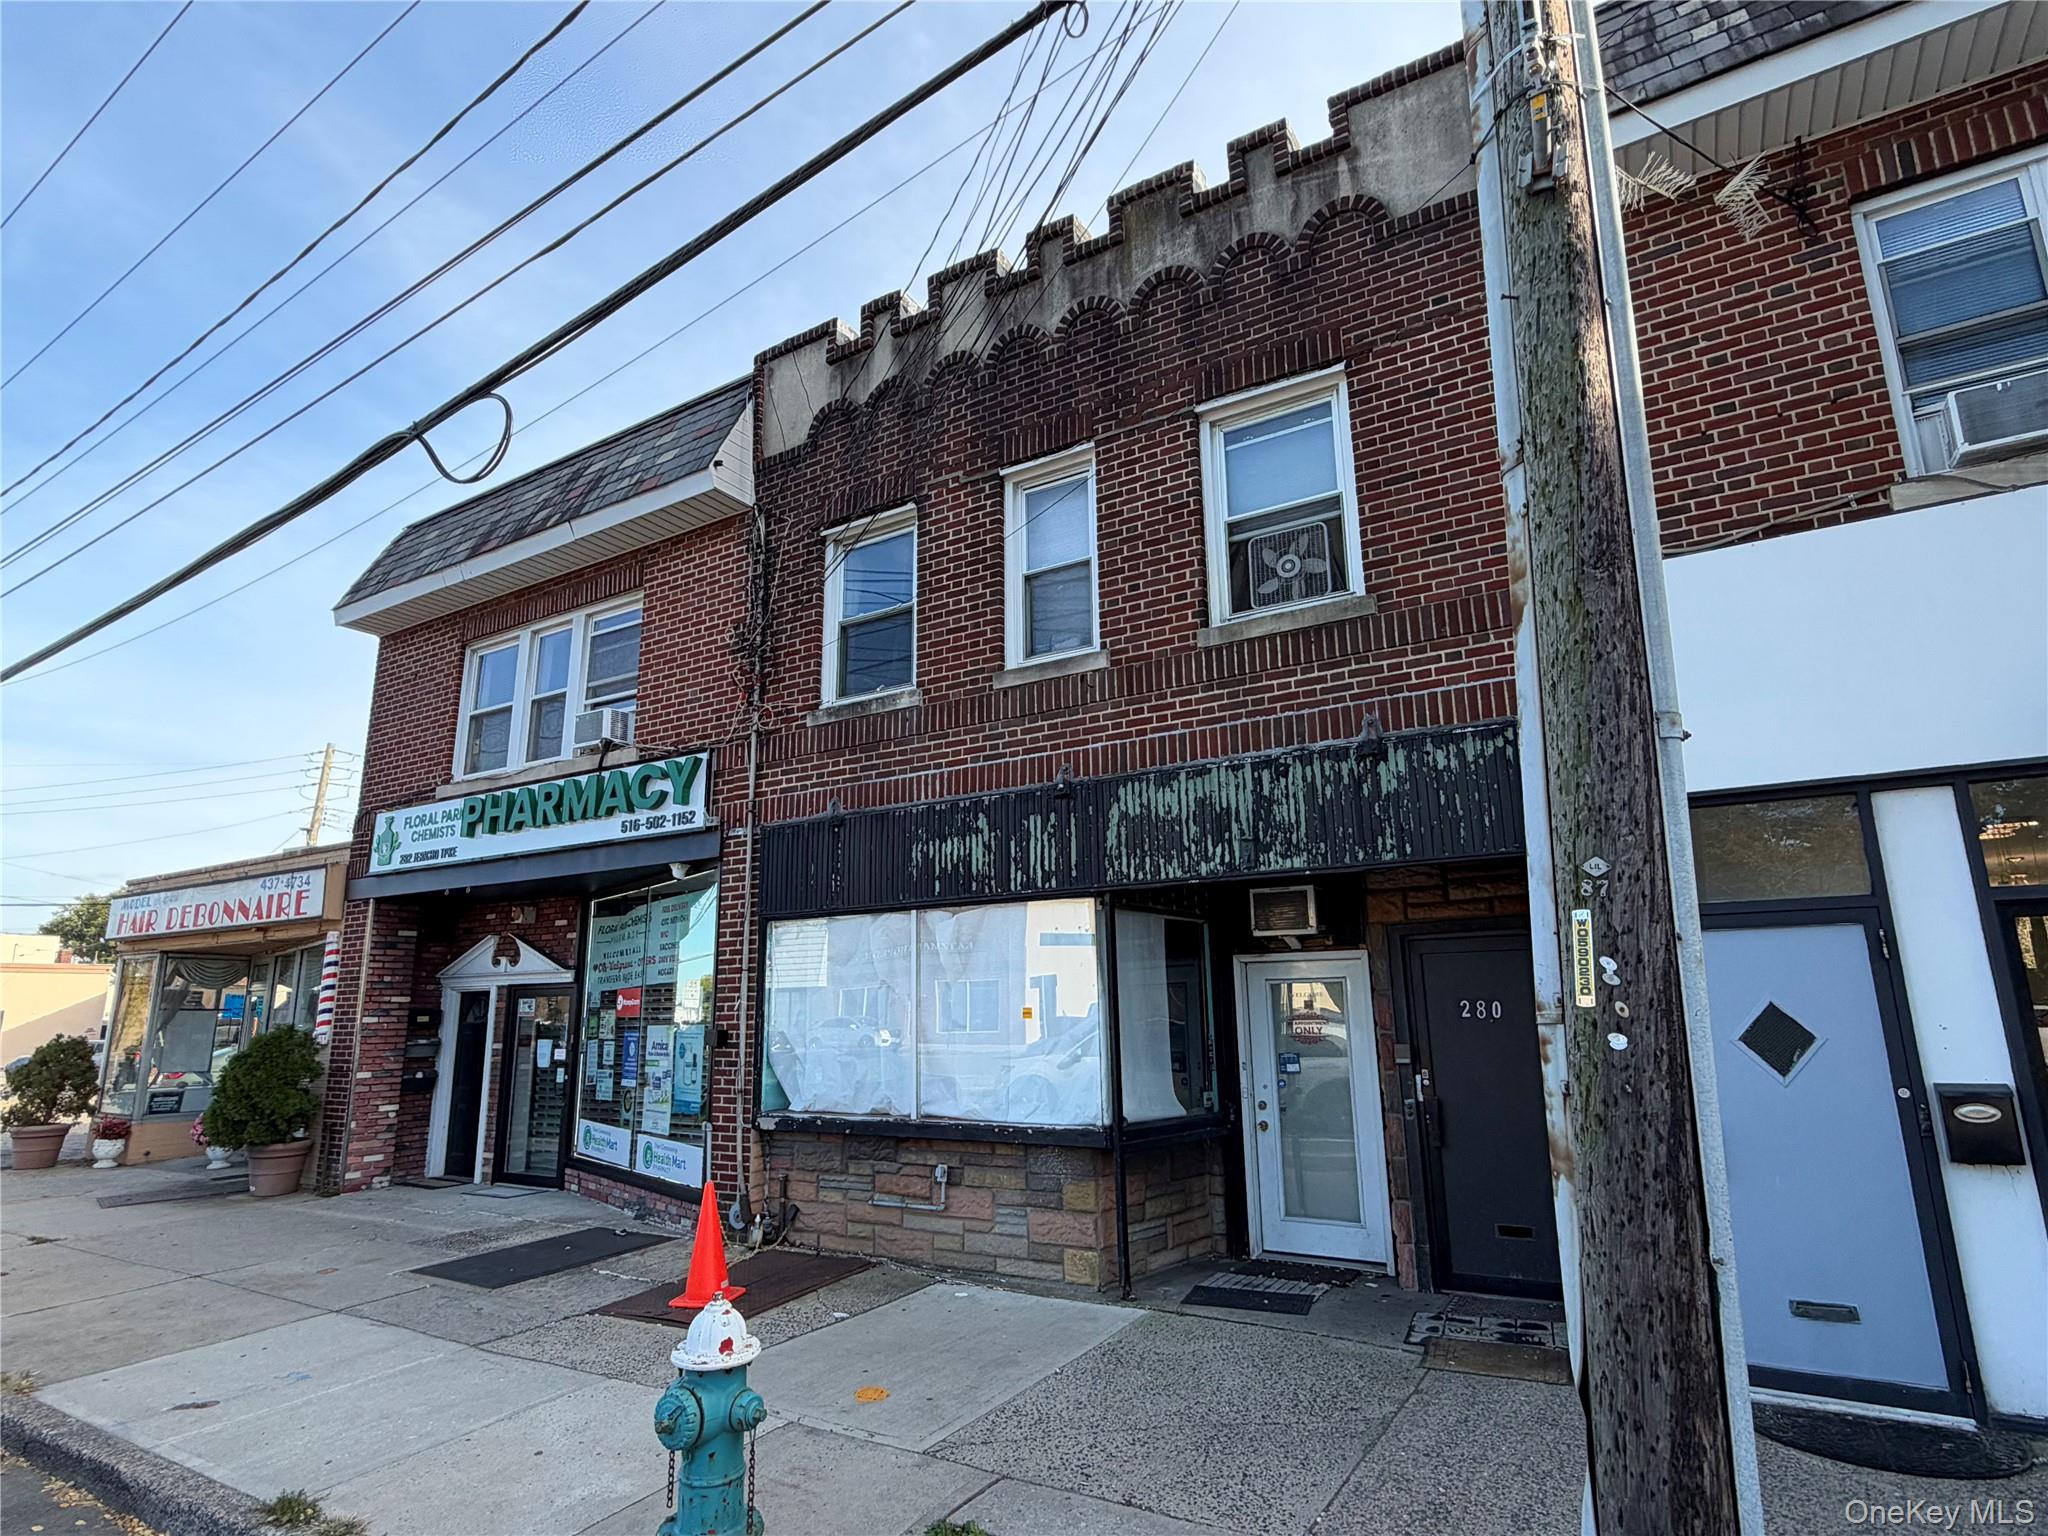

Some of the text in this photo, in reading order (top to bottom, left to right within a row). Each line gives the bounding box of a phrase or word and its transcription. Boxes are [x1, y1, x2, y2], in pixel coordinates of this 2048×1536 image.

[460, 756, 703, 838] PHARMACY
[403, 811, 440, 831] FLORAL
[620, 810, 697, 834] 516-502-1152
[411, 824, 456, 843] CHEMISTS
[1580, 879, 1609, 897] 87
[116, 888, 310, 936] HAIR DEBONNAIRE
[1460, 1000, 1502, 1019] 280
[1295, 1027, 1322, 1035] ONLY
